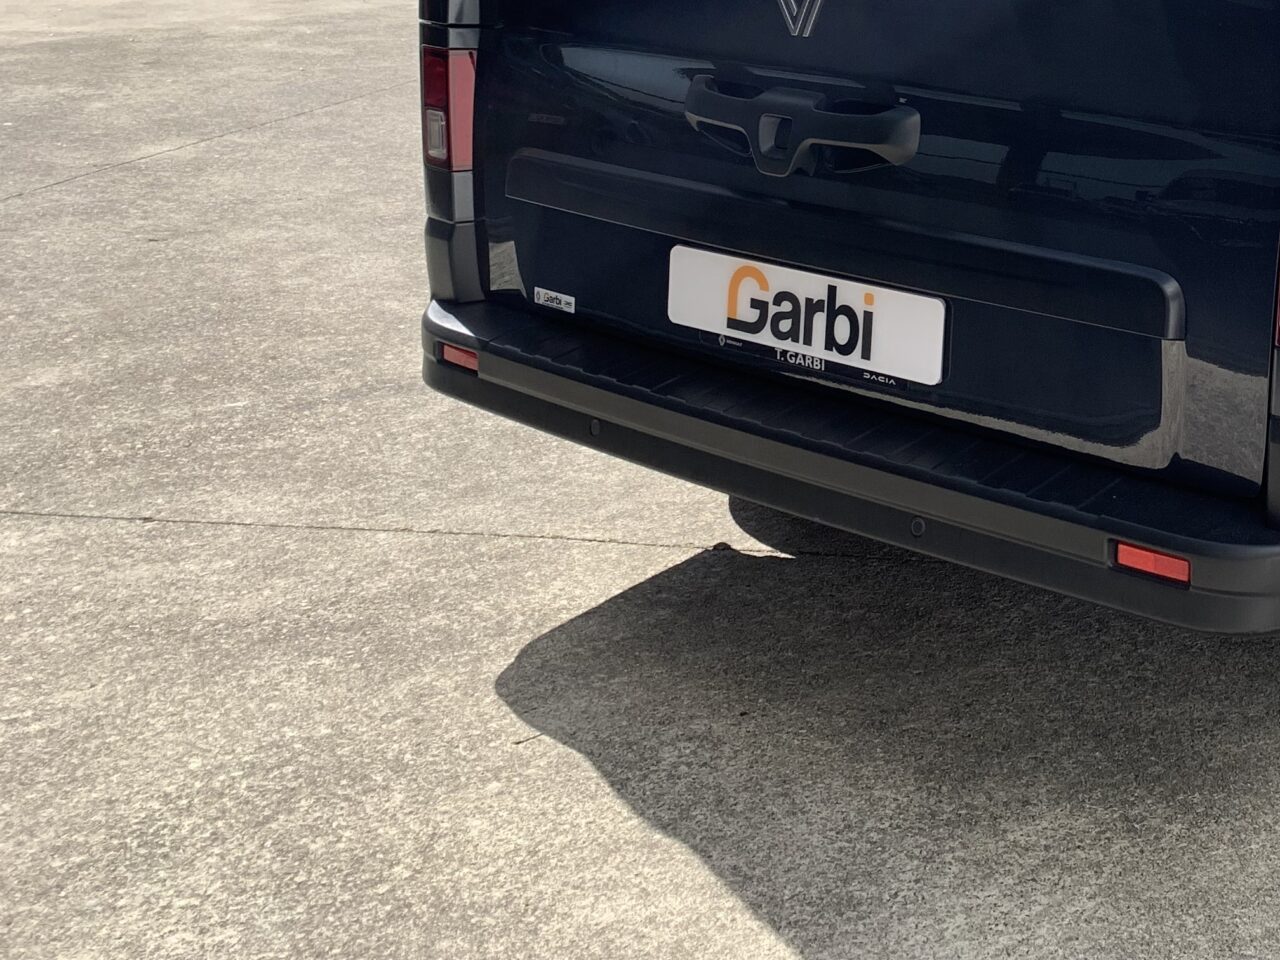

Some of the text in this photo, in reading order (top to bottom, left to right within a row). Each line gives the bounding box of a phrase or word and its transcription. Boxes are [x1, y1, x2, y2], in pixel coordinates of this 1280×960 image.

[726, 265, 875, 361] Garbi
[774, 347, 826, 372] T. GARBI
[862, 372, 897, 386] DACIA
